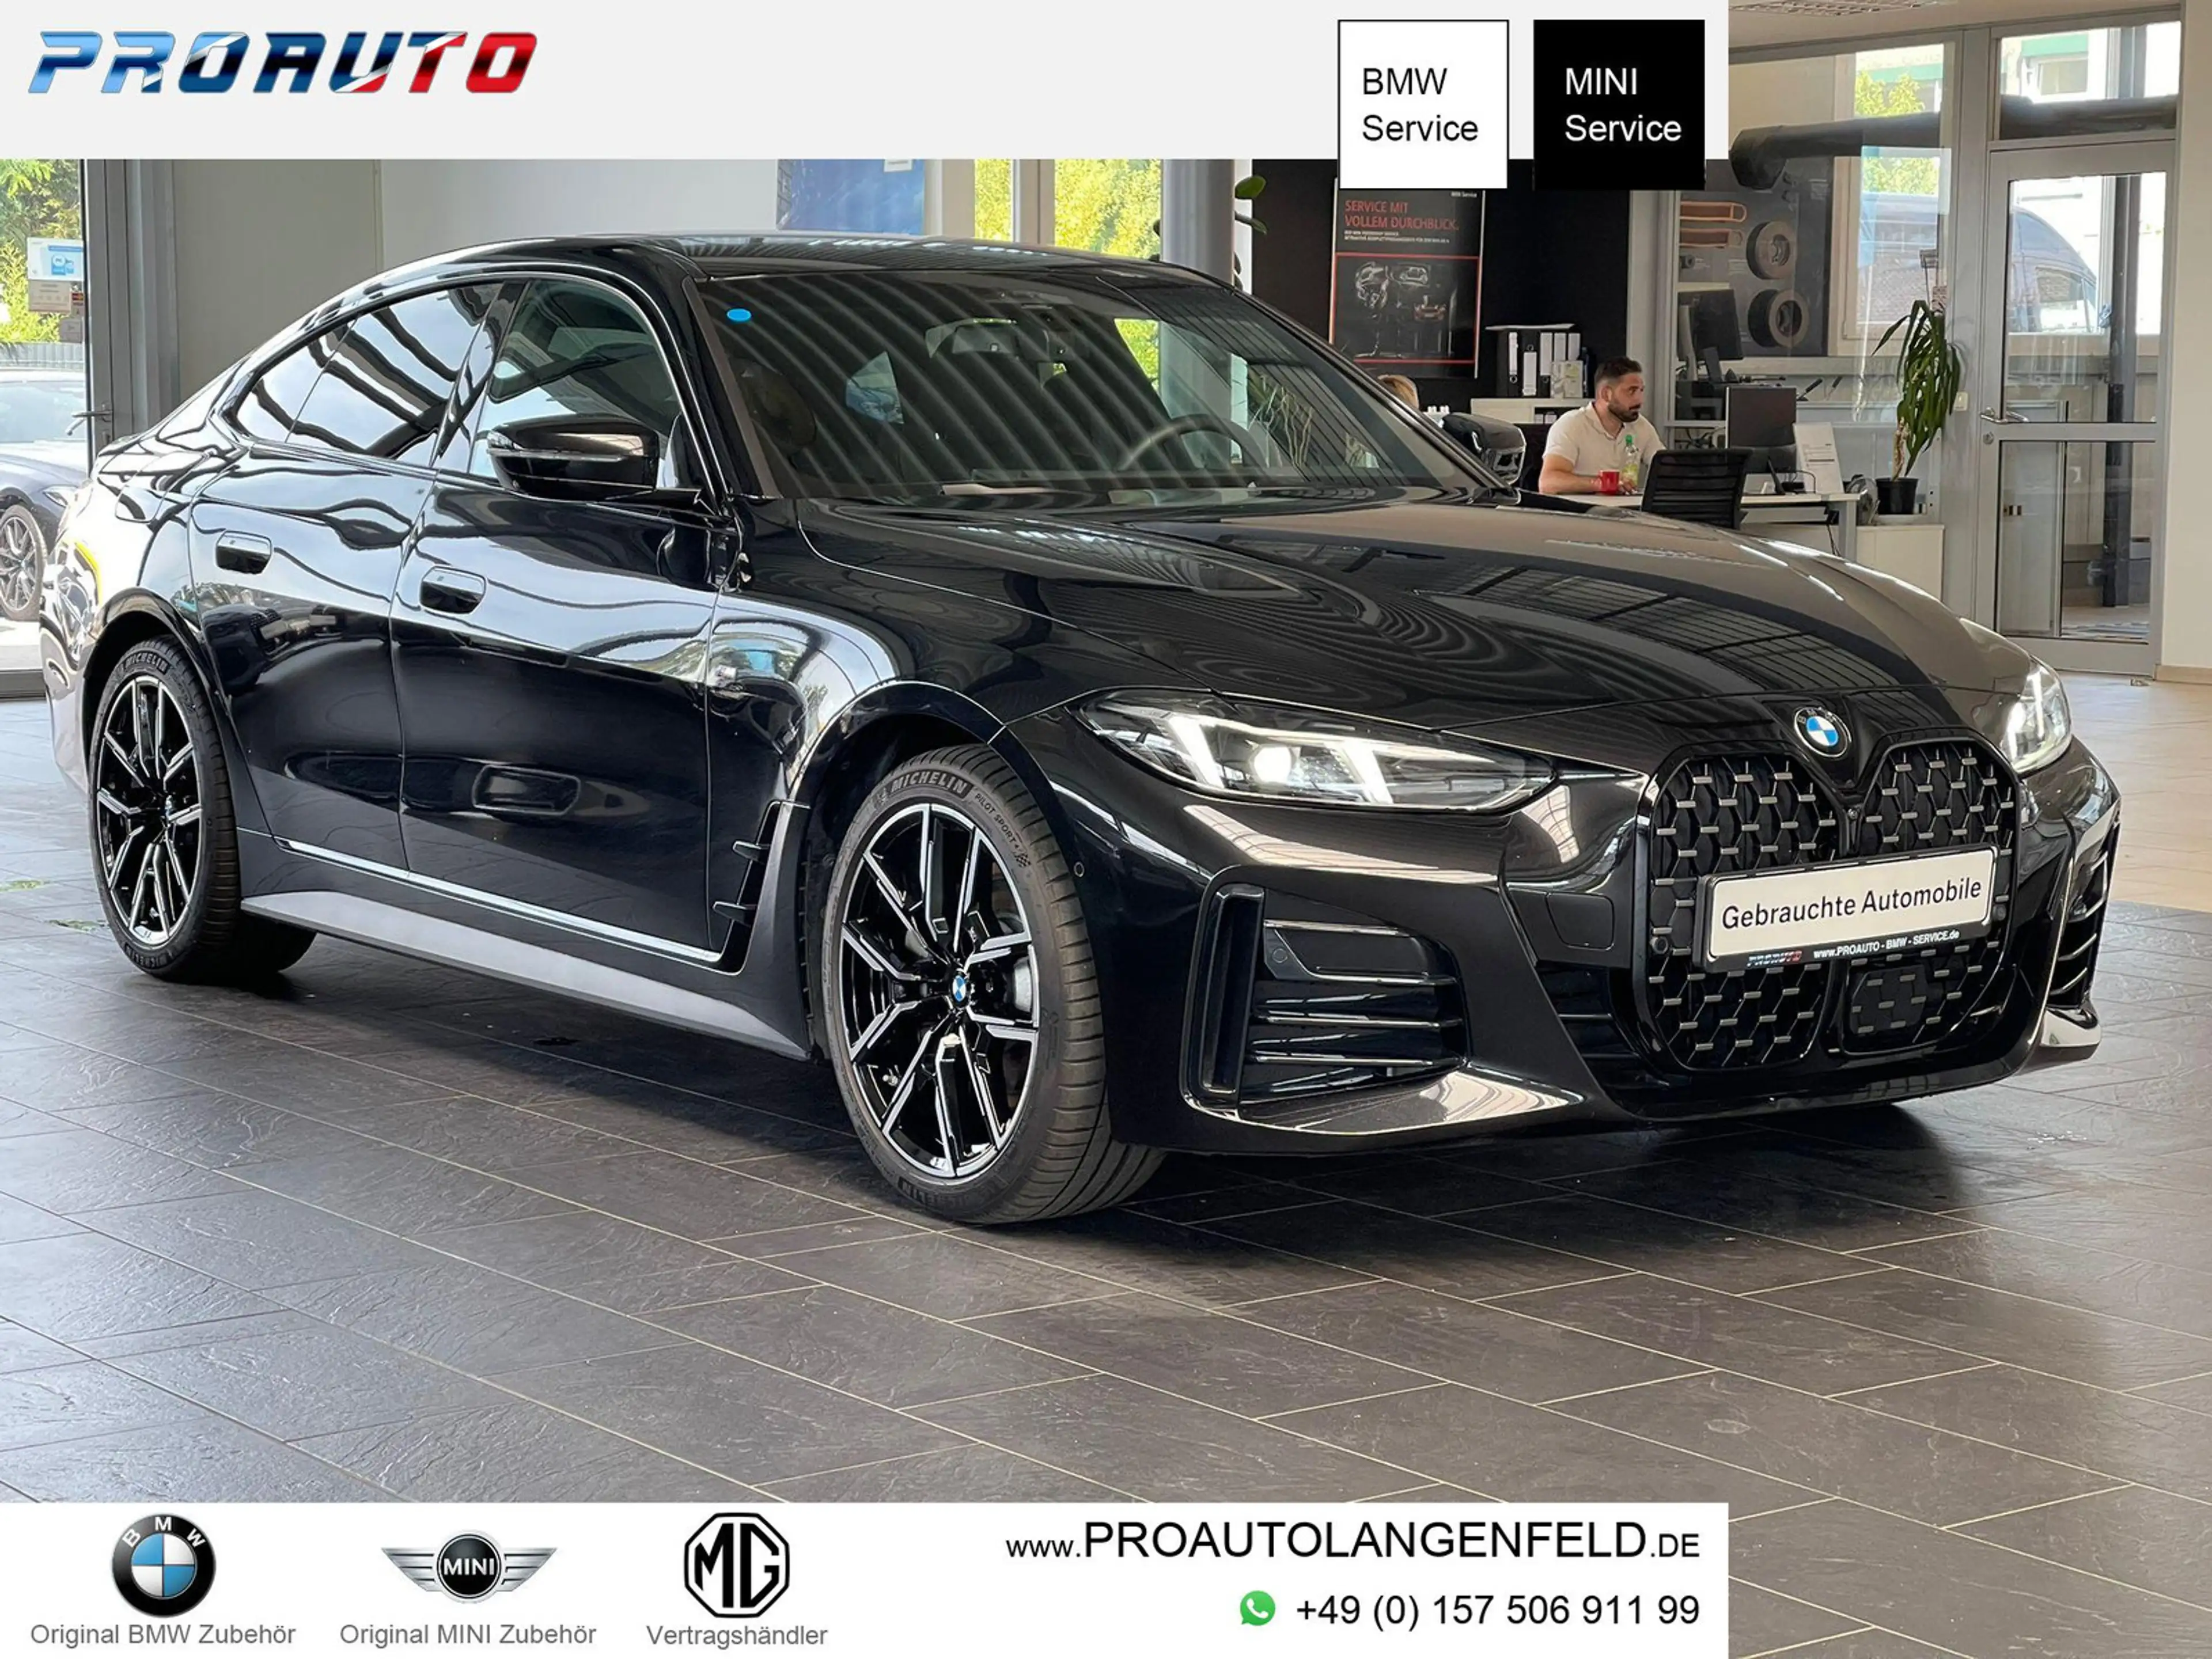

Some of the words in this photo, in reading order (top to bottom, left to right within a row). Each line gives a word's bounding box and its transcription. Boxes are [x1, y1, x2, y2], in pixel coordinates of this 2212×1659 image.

[1344, 200, 1387, 213] SERVICE
[1390, 202, 1408, 214] MIT
[1344, 215, 1388, 229] VOLLEM
[890, 771, 968, 794] MICHELIN
[975, 793, 995, 814] PILOT
[994, 814, 1017, 843] SPORT
[1722, 895, 1856, 930] Gebrauchte
[1861, 877, 1982, 915] Automobile
[1813, 941, 1880, 959] www.PROAUTO
[1885, 937, 1908, 949] BMW
[1912, 929, 1960, 945] SERVICE.de
